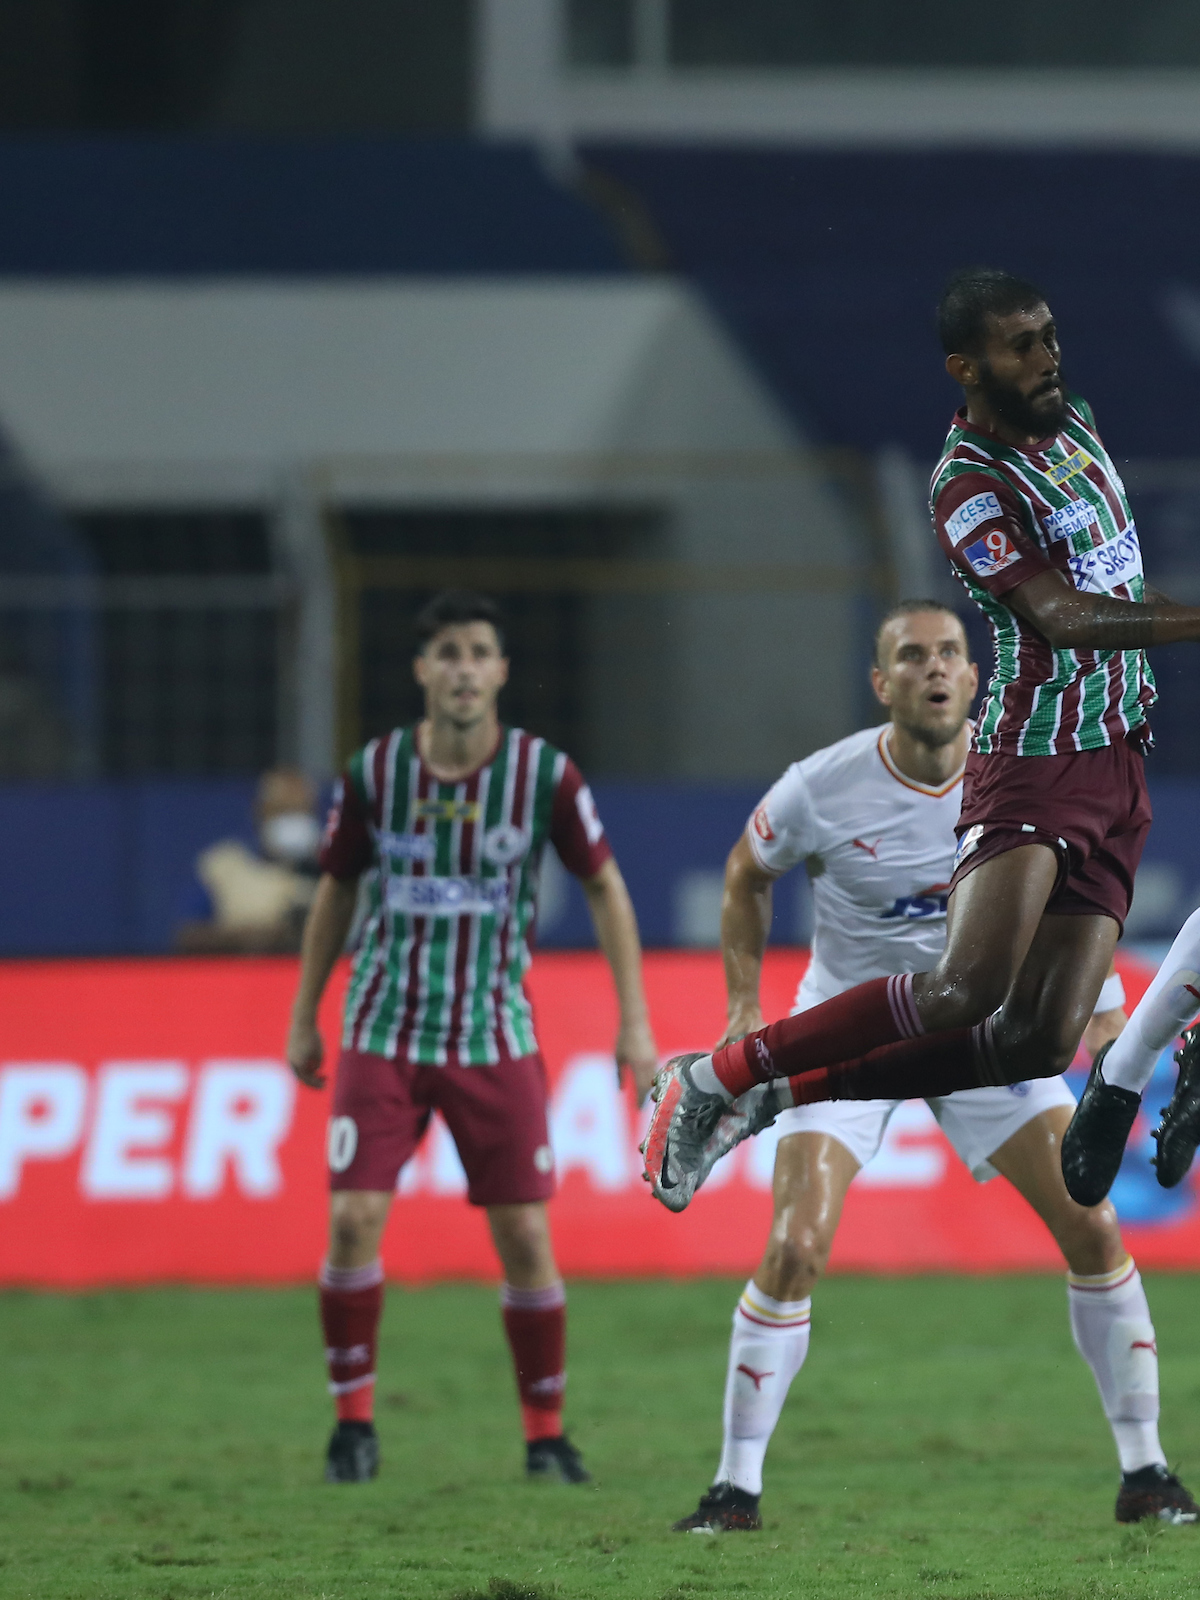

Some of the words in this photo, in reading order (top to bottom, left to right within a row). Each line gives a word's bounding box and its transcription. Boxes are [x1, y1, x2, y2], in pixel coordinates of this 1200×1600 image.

[960, 495, 998, 523] CESC
[1043, 512, 1064, 529] MP
[1054, 510, 1096, 540] CEMENT
[880, 895, 948, 918] JS
